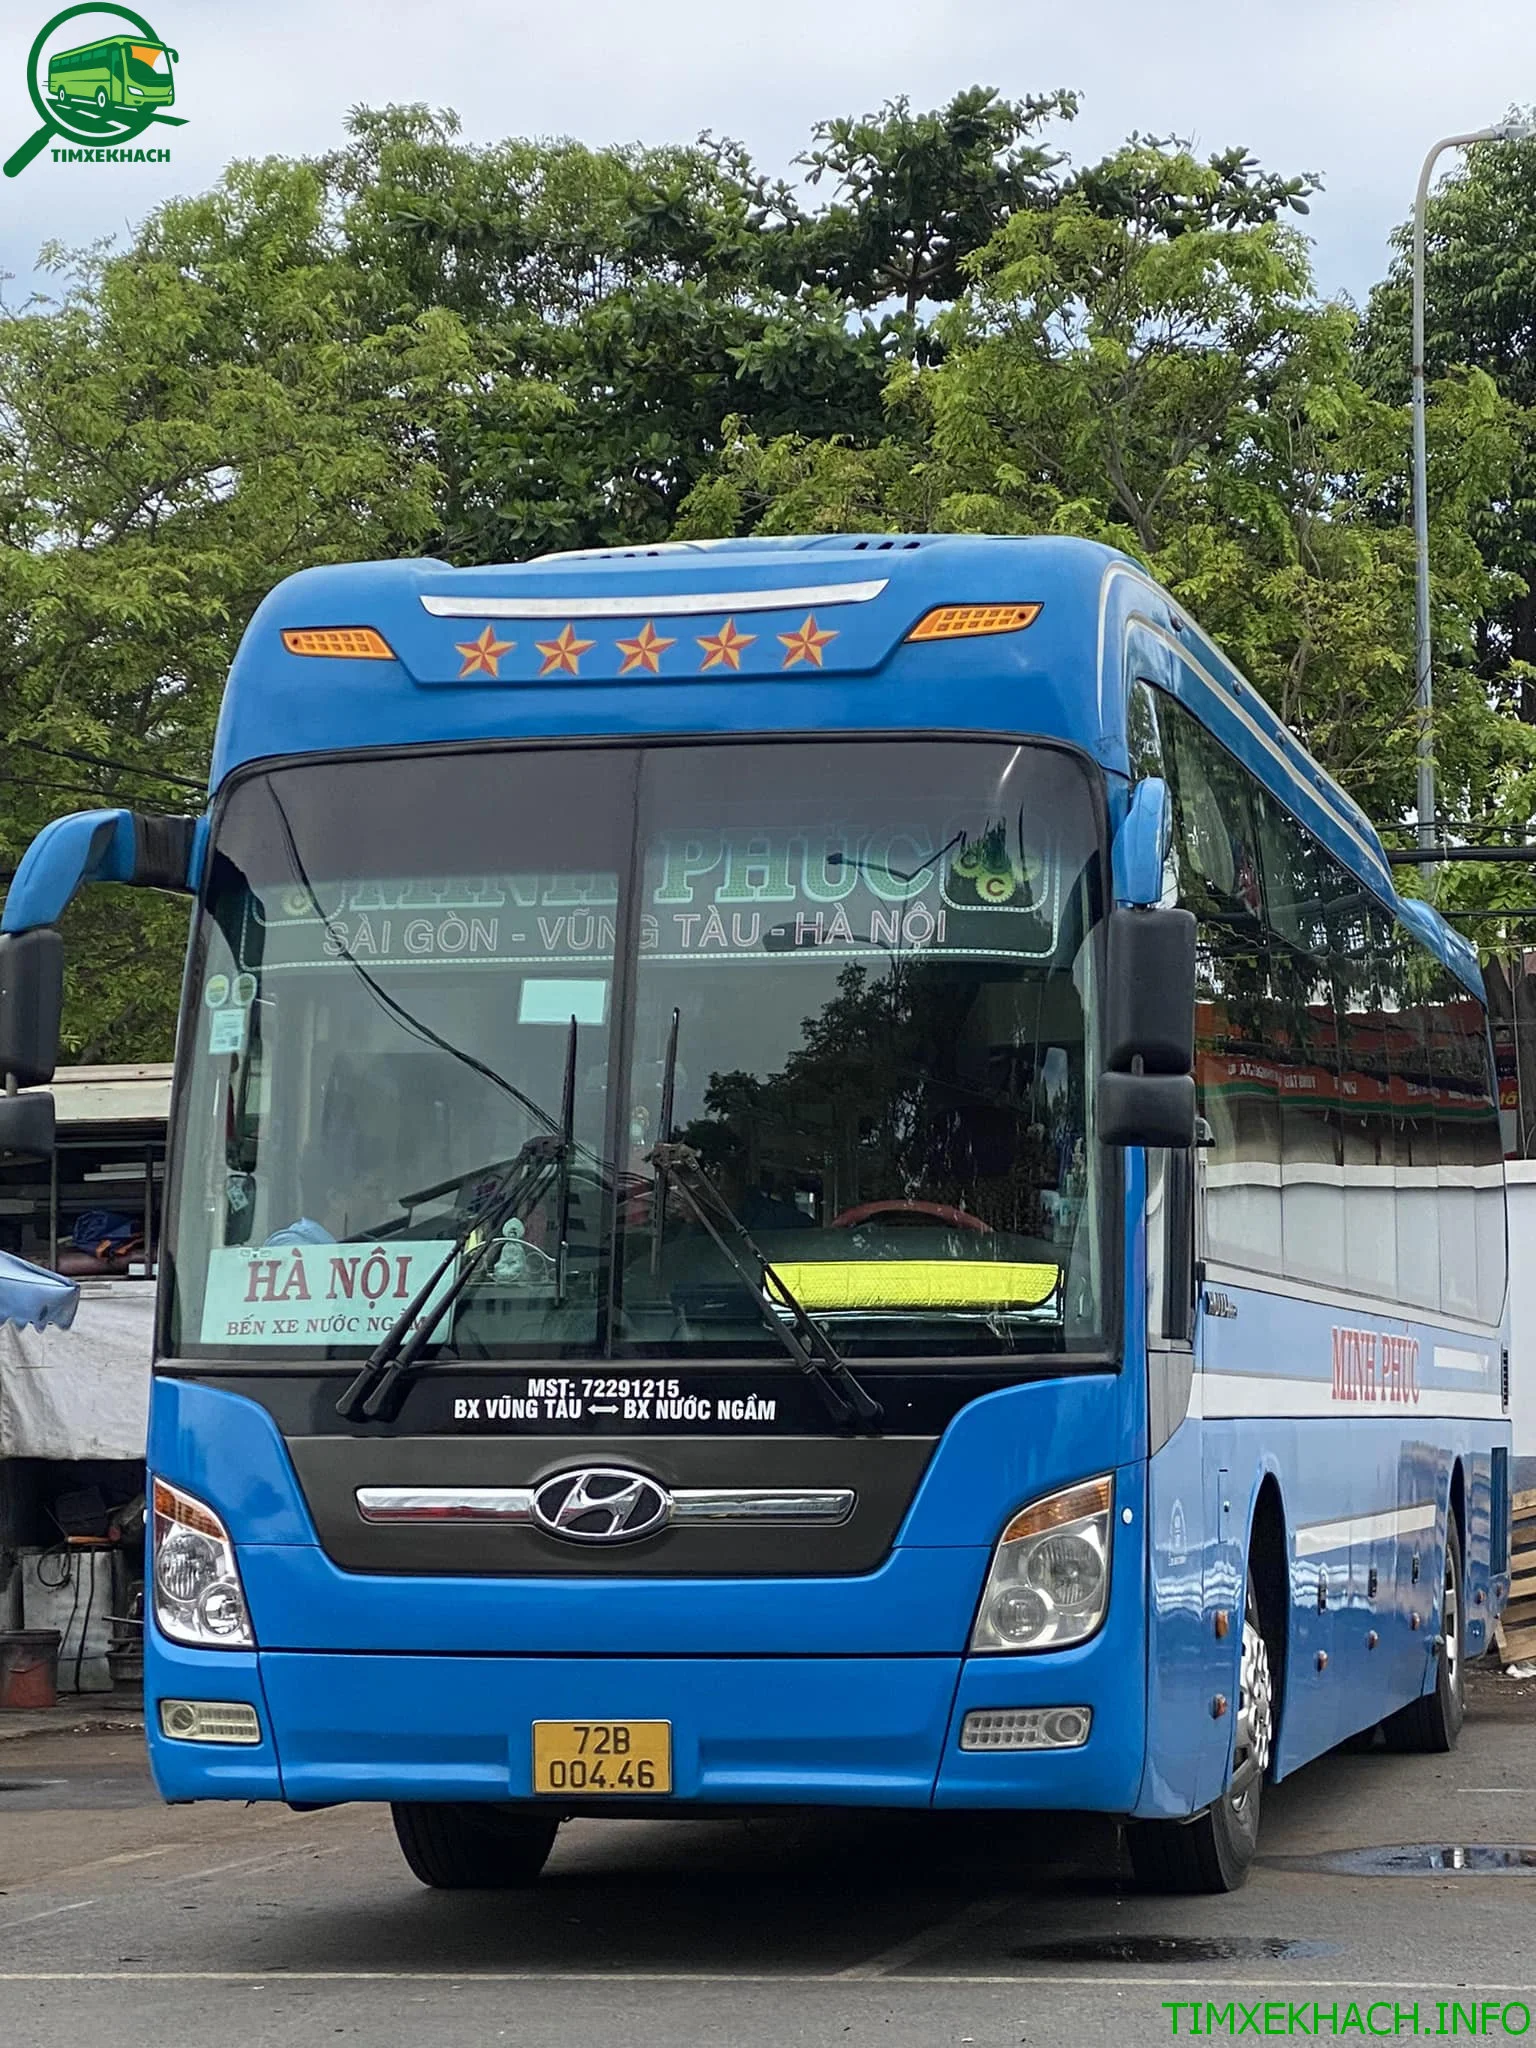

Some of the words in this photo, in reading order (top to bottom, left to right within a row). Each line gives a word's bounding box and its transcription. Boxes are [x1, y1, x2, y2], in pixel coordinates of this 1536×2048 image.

[323, 912, 391, 955] SÀI
[404, 911, 498, 953] GÒN
[673, 905, 760, 947] TÀU
[795, 902, 854, 944] HÀ
[870, 902, 946, 949] NỘI
[244, 1247, 311, 1302] HÀ
[325, 1246, 412, 1309] NỘI
[226, 1313, 265, 1335] BẾN
[272, 1319, 299, 1334] XE
[306, 1314, 360, 1333] NƯỚC
[1331, 1326, 1377, 1401] MINH
[528, 1379, 576, 1398] MST:
[581, 1379, 680, 1398] 72291215
[454, 1400, 480, 1419] BX
[485, 1395, 538, 1419] VŨNG
[546, 1395, 582, 1419] TÀU
[623, 1400, 650, 1420] BX
[655, 1396, 711, 1420] NƯỚC
[717, 1393, 776, 1420] NGẦM
[573, 1726, 630, 1754] 72B
[550, 1760, 655, 1788] 004.46
